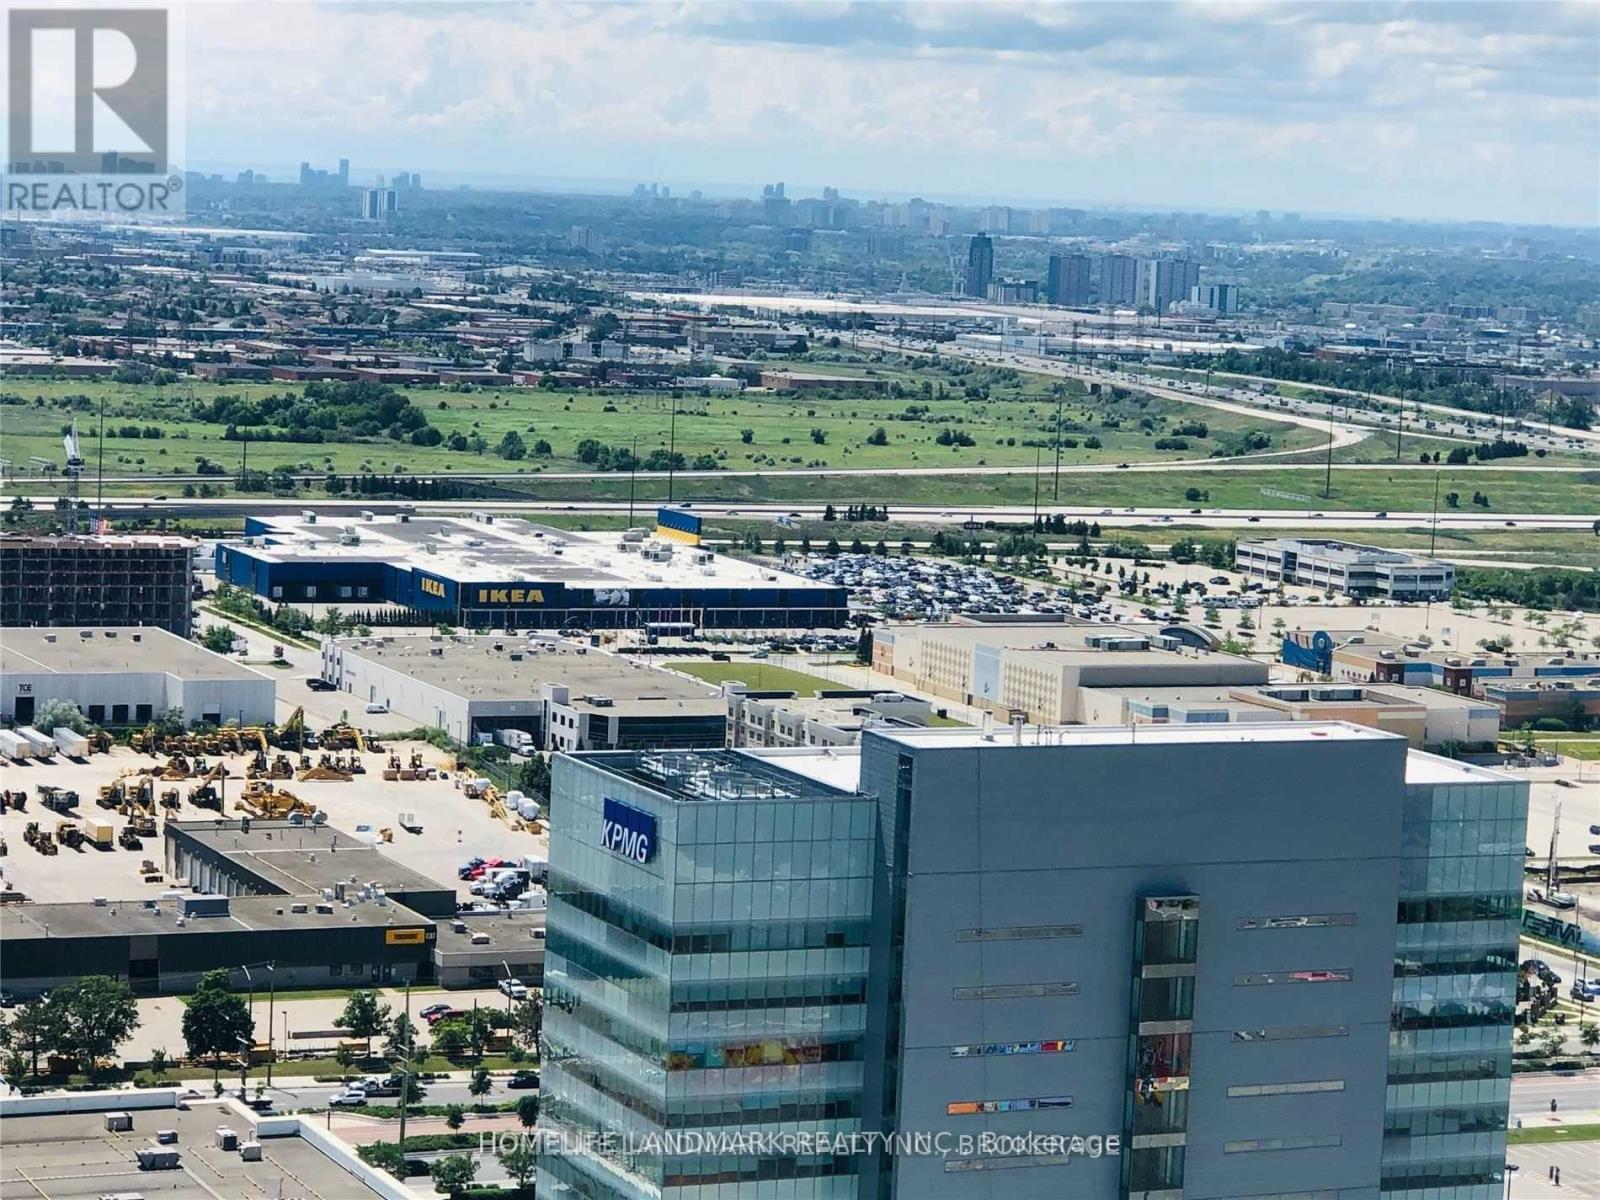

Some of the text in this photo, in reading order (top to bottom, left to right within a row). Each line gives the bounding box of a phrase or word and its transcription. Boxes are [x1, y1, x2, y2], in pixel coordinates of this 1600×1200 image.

[421, 577, 445, 598] IKEA
[478, 589, 544, 603] IKEA
[600, 818, 648, 864] KPMG
